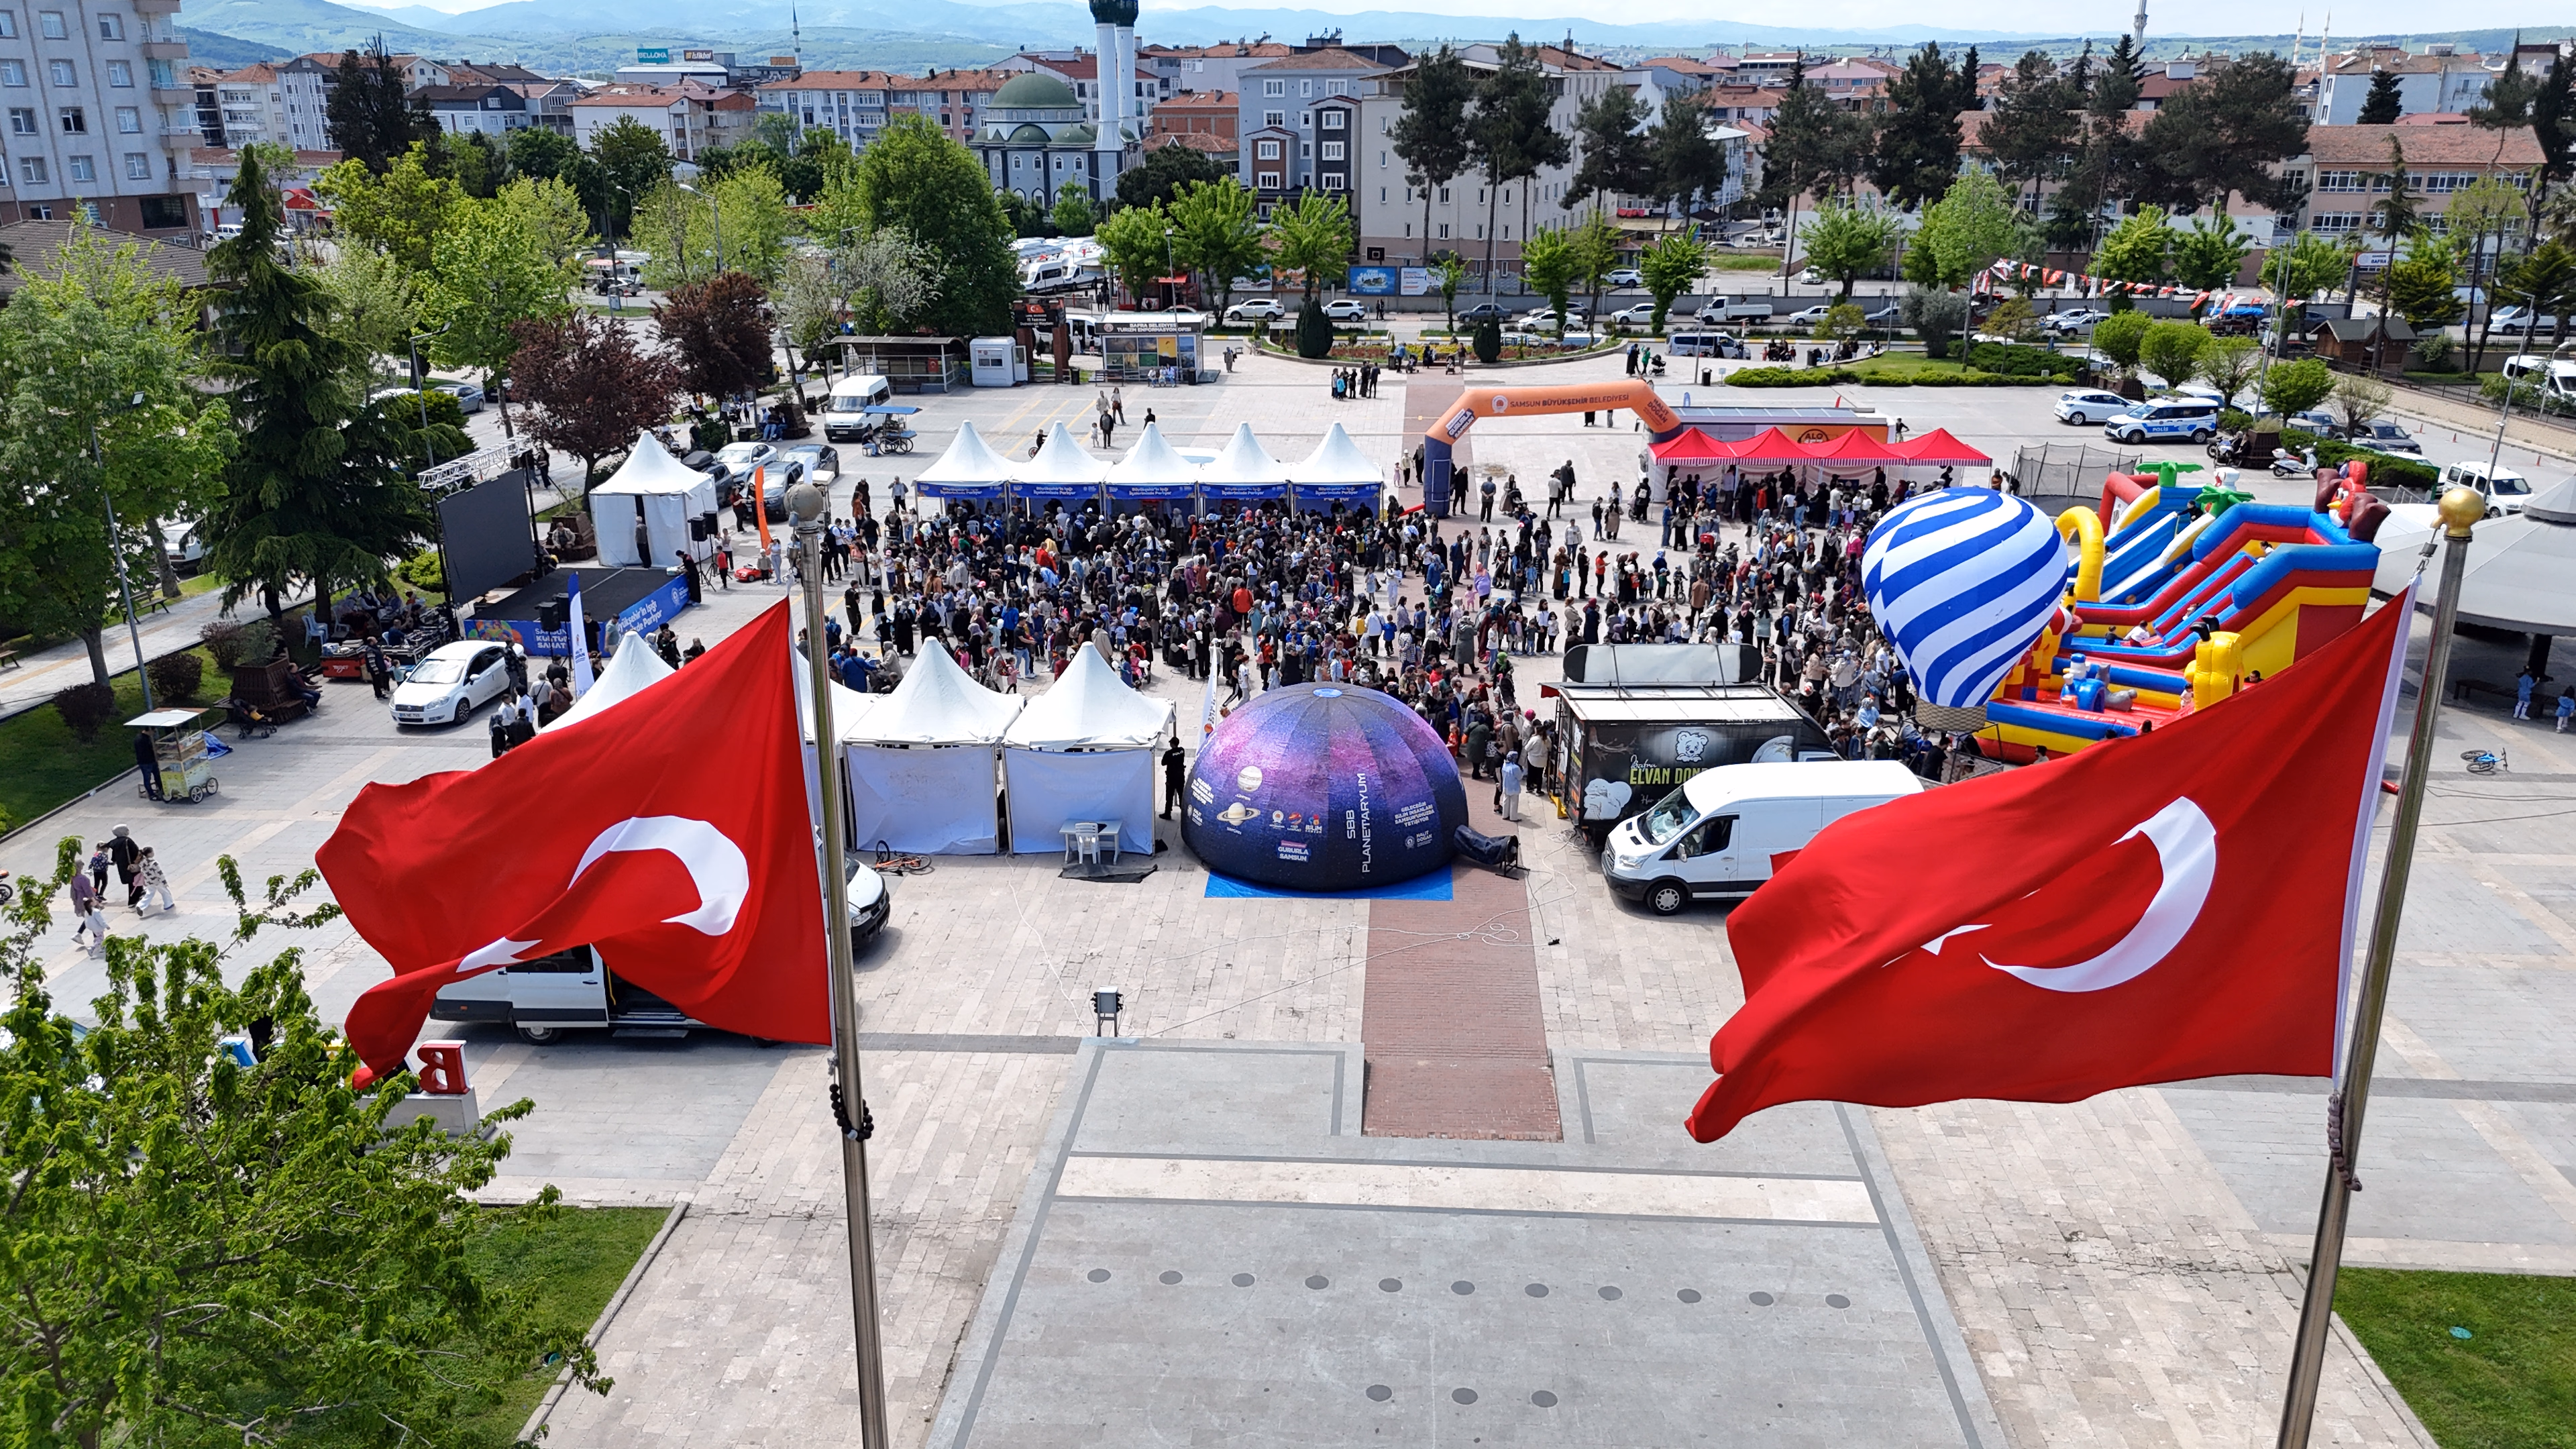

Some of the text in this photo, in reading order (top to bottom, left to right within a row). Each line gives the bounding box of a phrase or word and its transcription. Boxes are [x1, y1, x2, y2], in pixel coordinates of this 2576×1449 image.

[1542, 396, 1588, 407] BÜYÜKŞEHİR
[1589, 392, 1629, 404] BELEDİYESİ
[1630, 754, 1658, 772] Bafra
[1629, 767, 1670, 785] ELVAN
[1346, 809, 1356, 839] SBB
[1356, 773, 1371, 873] PLANETARYUM
[1277, 846, 1309, 855] GURURLA
[1279, 853, 1307, 862] SAMSUN
